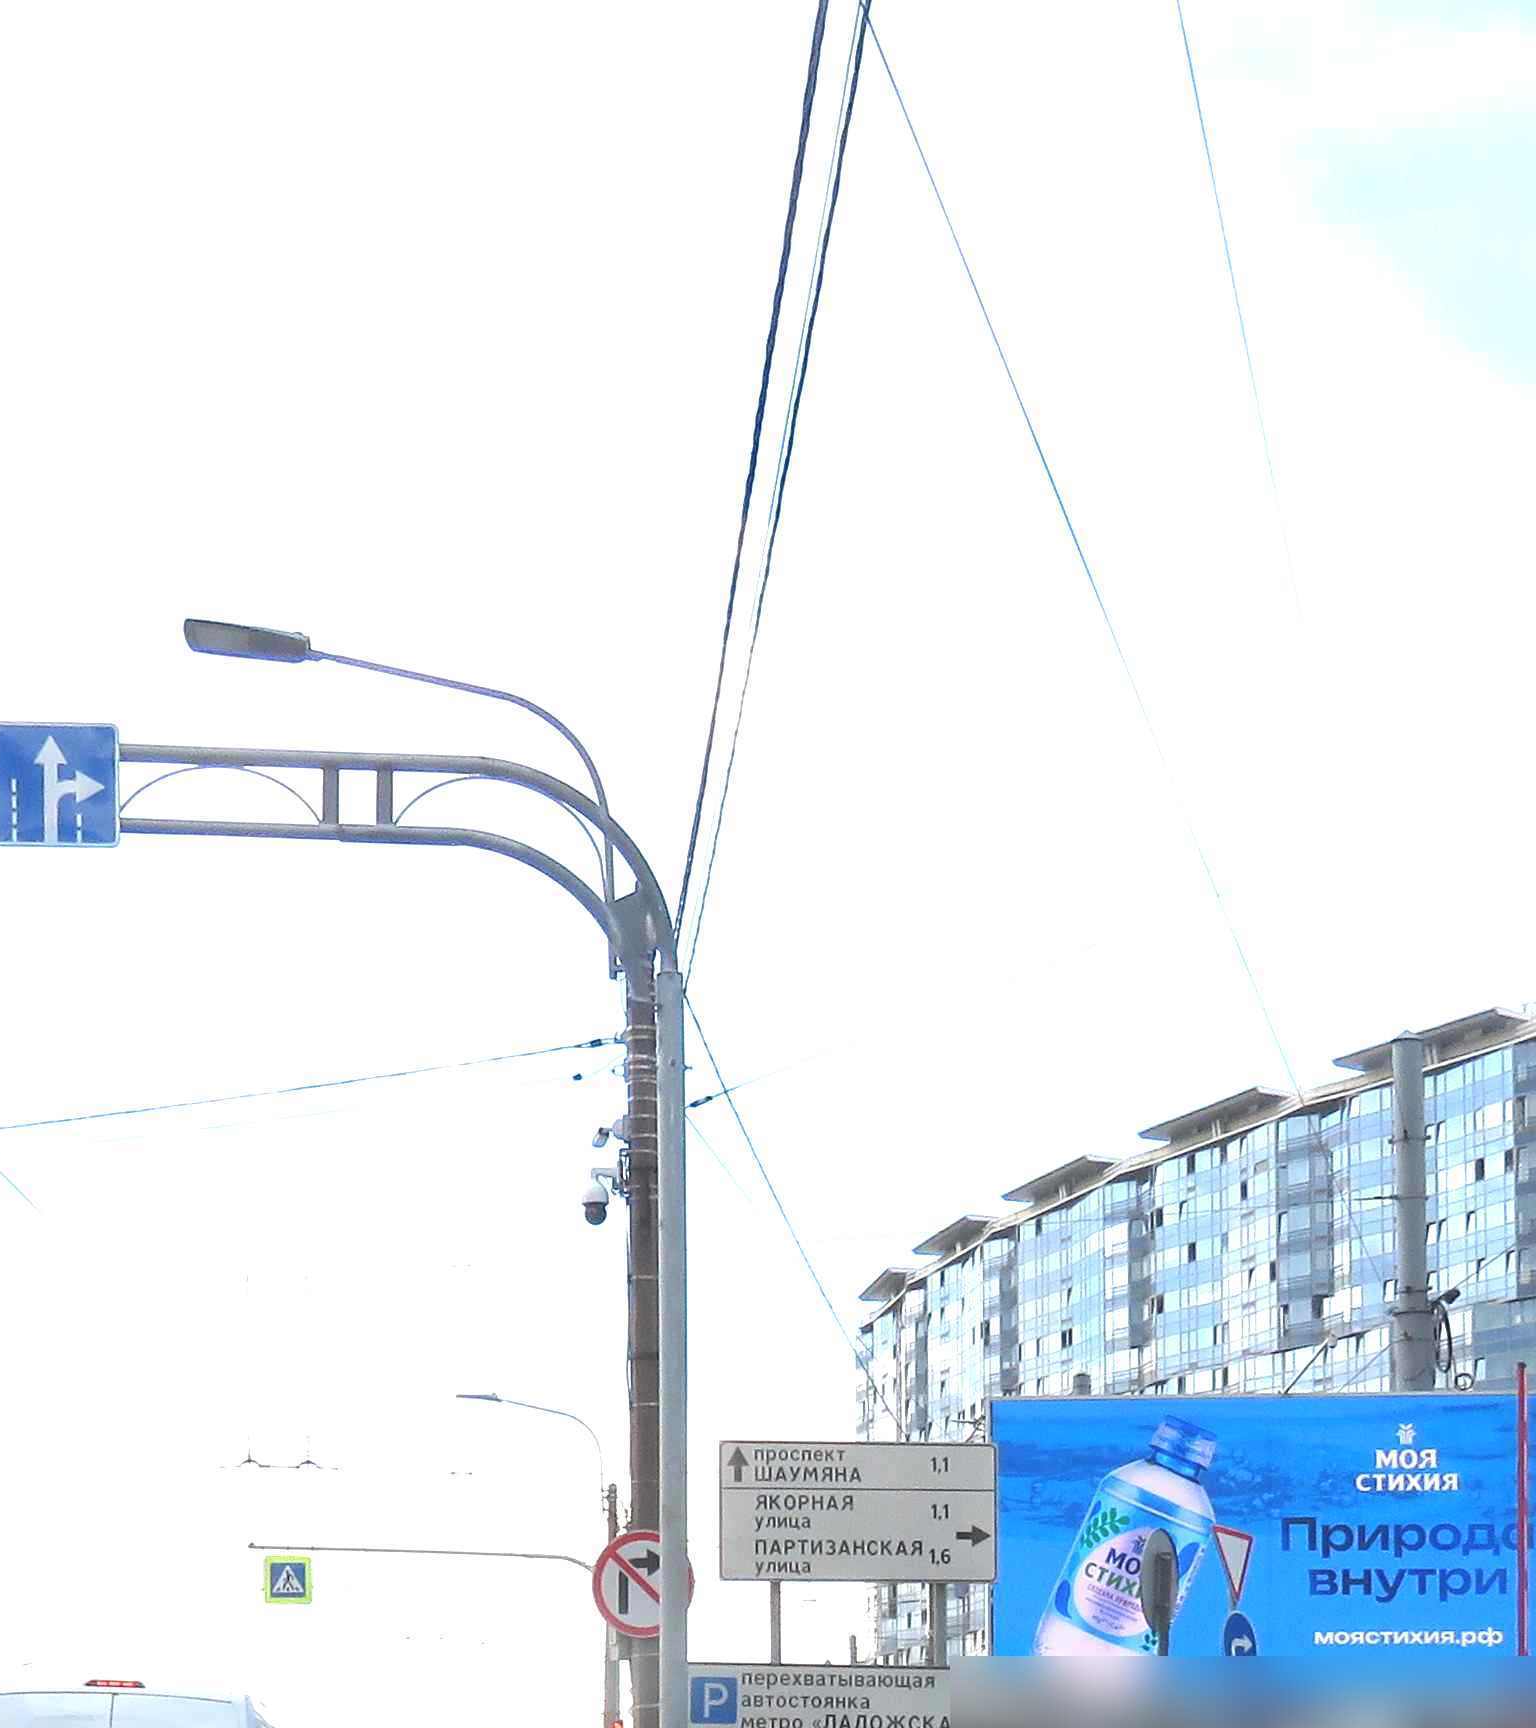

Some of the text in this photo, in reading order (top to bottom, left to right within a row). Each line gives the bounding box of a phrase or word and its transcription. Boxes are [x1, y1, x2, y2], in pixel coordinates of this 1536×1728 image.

[754, 1448, 845, 1466] проспект
[930, 1457, 949, 1474] 1,1
[1375, 1449, 1438, 1469] МОЯ
[754, 1466, 862, 1482] ШАУМЯНА
[1355, 1473, 1459, 1492] СТИХИЯ
[755, 1496, 854, 1511] ЯКОРНАЯ
[930, 1504, 949, 1520] 1,1
[755, 1515, 811, 1532] улица
[1281, 1517, 1535, 1558] Природа
[755, 1540, 923, 1556] ПАРТИЗАНСКАЯ
[929, 1549, 951, 1566] 1,6
[1105, 1548, 1141, 1575] МО
[755, 1560, 811, 1577] улица
[1084, 1562, 1143, 1599] СТИХ
[1309, 1568, 1508, 1602] внутри
[1314, 1626, 1504, 1647] моястихия.рф
[741, 1671, 936, 1690] перехватывающая
[741, 1694, 870, 1710] автостоянка
